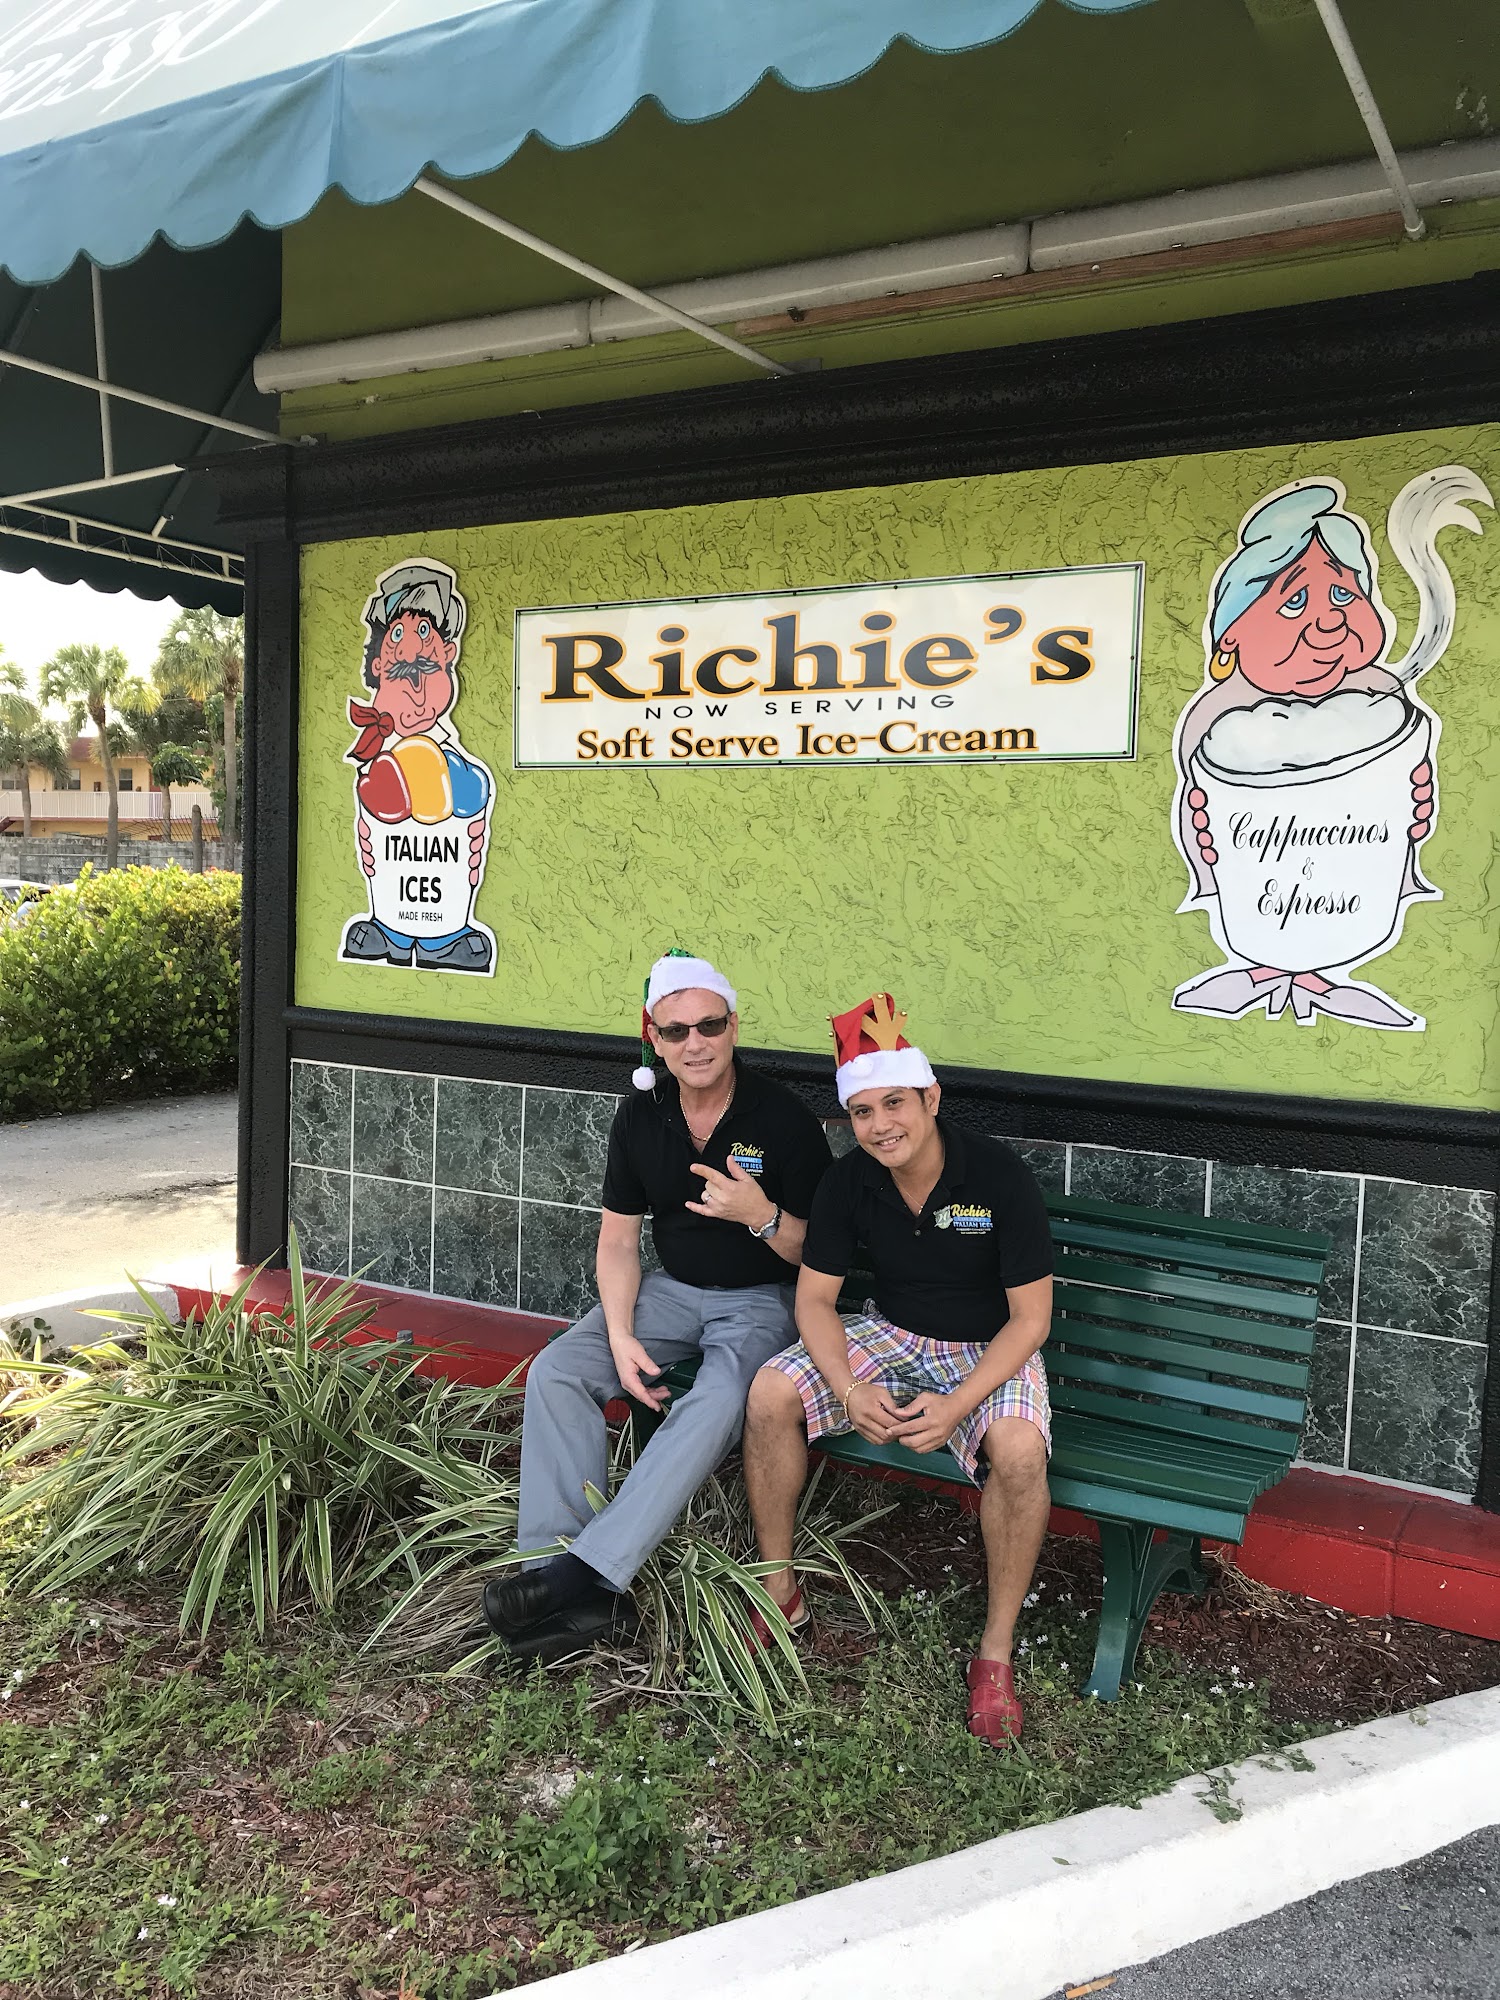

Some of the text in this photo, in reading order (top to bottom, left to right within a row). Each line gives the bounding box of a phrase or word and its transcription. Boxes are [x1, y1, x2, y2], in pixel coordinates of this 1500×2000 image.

[540, 605, 1096, 704] Richie's
[645, 694, 957, 720] NOW SERVING
[576, 722, 1039, 760] Soft Serve Ice-Cream
[385, 835, 459, 863] ITALIAN
[1228, 811, 1391, 862] Cappuccinos
[1302, 857, 1315, 880] &
[399, 876, 442, 904] ICES
[1257, 878, 1361, 930] Espresso
[398, 911, 443, 922] MADE FRESH
[950, 1203, 992, 1217] Richie's
